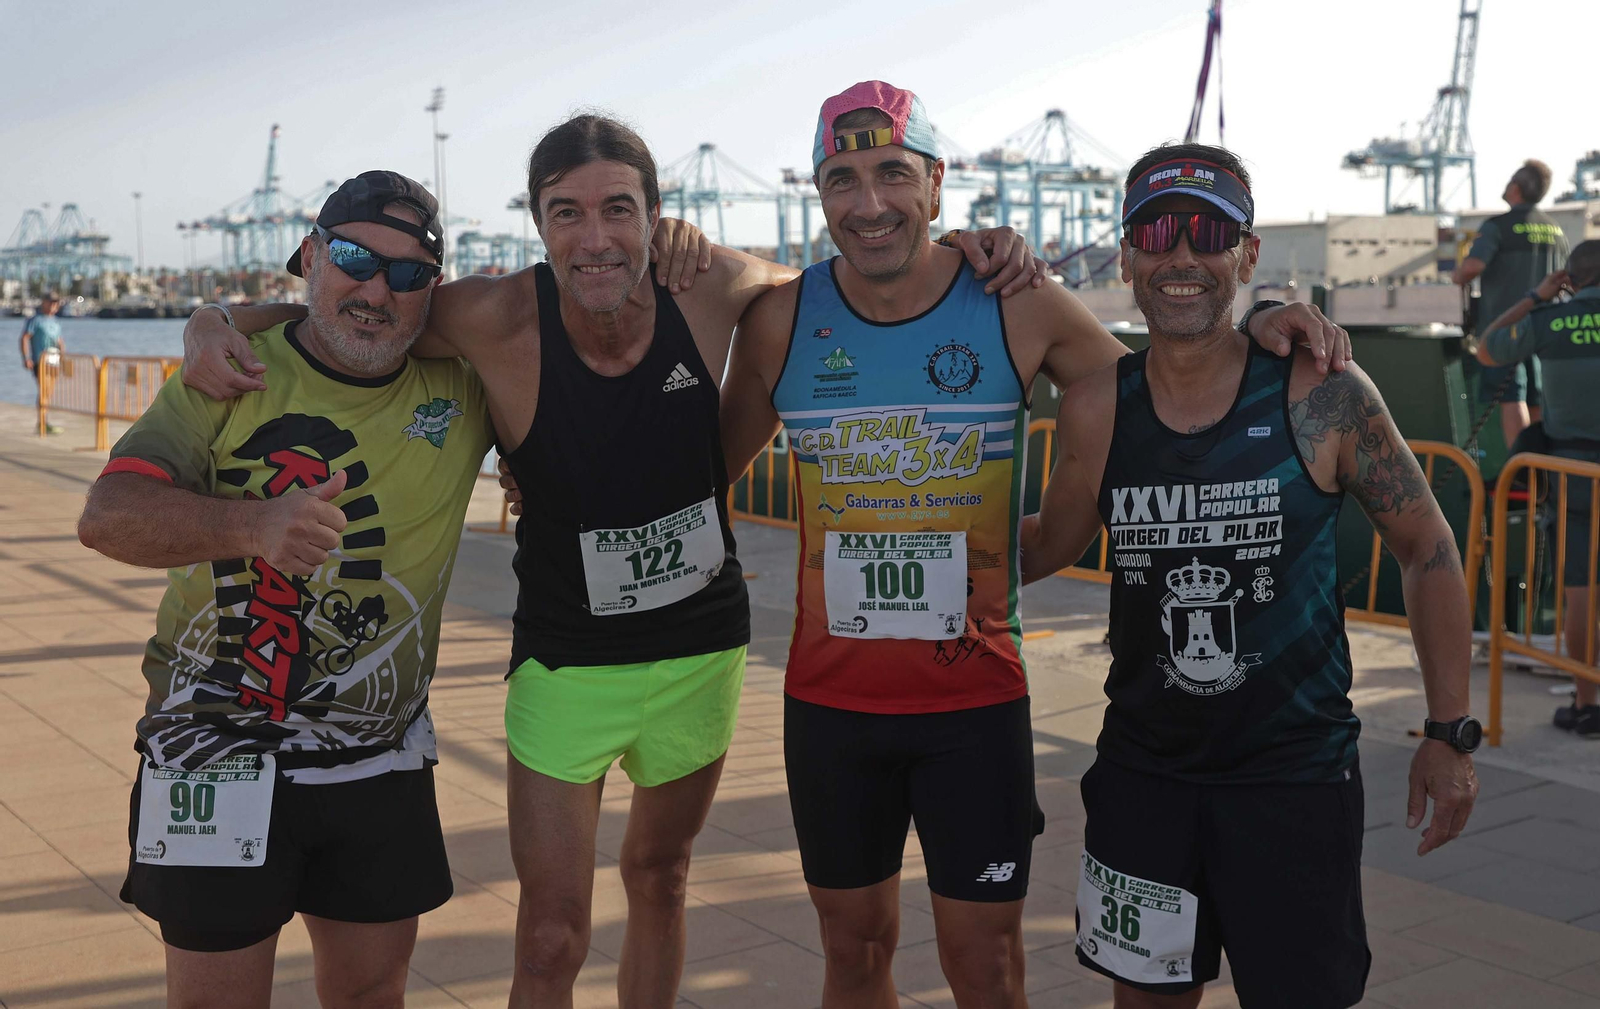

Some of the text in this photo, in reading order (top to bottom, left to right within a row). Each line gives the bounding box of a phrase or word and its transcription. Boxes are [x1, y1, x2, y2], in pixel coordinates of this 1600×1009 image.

[1149, 164, 1215, 184] IRONMAN
[1148, 178, 1172, 192] 70.3
[1527, 233, 1556, 245] CIVIL
[662, 377, 699, 392] adidas
[939, 384, 955, 392] SINCE
[836, 415, 922, 449] TRAIL
[821, 449, 899, 477] TEAM
[1199, 478, 1279, 500] CARRERA
[845, 491, 982, 509] Gabarras & Servicios
[1111, 484, 1197, 524] XXVI
[1199, 495, 1281, 518] POPULAR
[659, 503, 703, 527] CARRERA
[659, 509, 703, 533] POPULAR
[594, 523, 658, 543] XXVI
[598, 517, 705, 552] VIRGEN DEL PILAR
[838, 533, 897, 549] XXVI
[1113, 520, 1280, 547] VIRGEN DEL PILAR
[624, 538, 686, 581] 122
[840, 550, 950, 559] VIRGEN DEL PILAR
[1114, 553, 1152, 568] GUARDIA
[1234, 544, 1282, 560] 2024
[619, 581, 639, 592] JUAN
[640, 575, 671, 588] MONTES
[672, 571, 682, 580] DE
[684, 564, 698, 576] OCA
[860, 561, 924, 600] 100
[1124, 570, 1148, 585] CIVIL
[593, 604, 626, 613] Algeciras
[858, 601, 929, 611] JOSÉ MANUEL LEAL
[830, 624, 857, 634] Algeciras
[1214, 661, 1247, 692] ALGECIRAS
[218, 756, 257, 764] RRERA
[187, 772, 210, 781] DEL
[217, 772, 257, 781] PILAR
[170, 781, 216, 823] 90
[167, 825, 217, 835] MANUEL JAEN
[1085, 854, 1126, 890] XXVI
[1128, 879, 1182, 895] CARRERA
[1128, 885, 1181, 902] POPULAR
[1113, 889, 1134, 902] DEL
[1140, 899, 1179, 913] PILAR
[1101, 895, 1141, 942] 36
[1092, 927, 1117, 946] JACINTO
[1118, 940, 1151, 958] DELGADO
